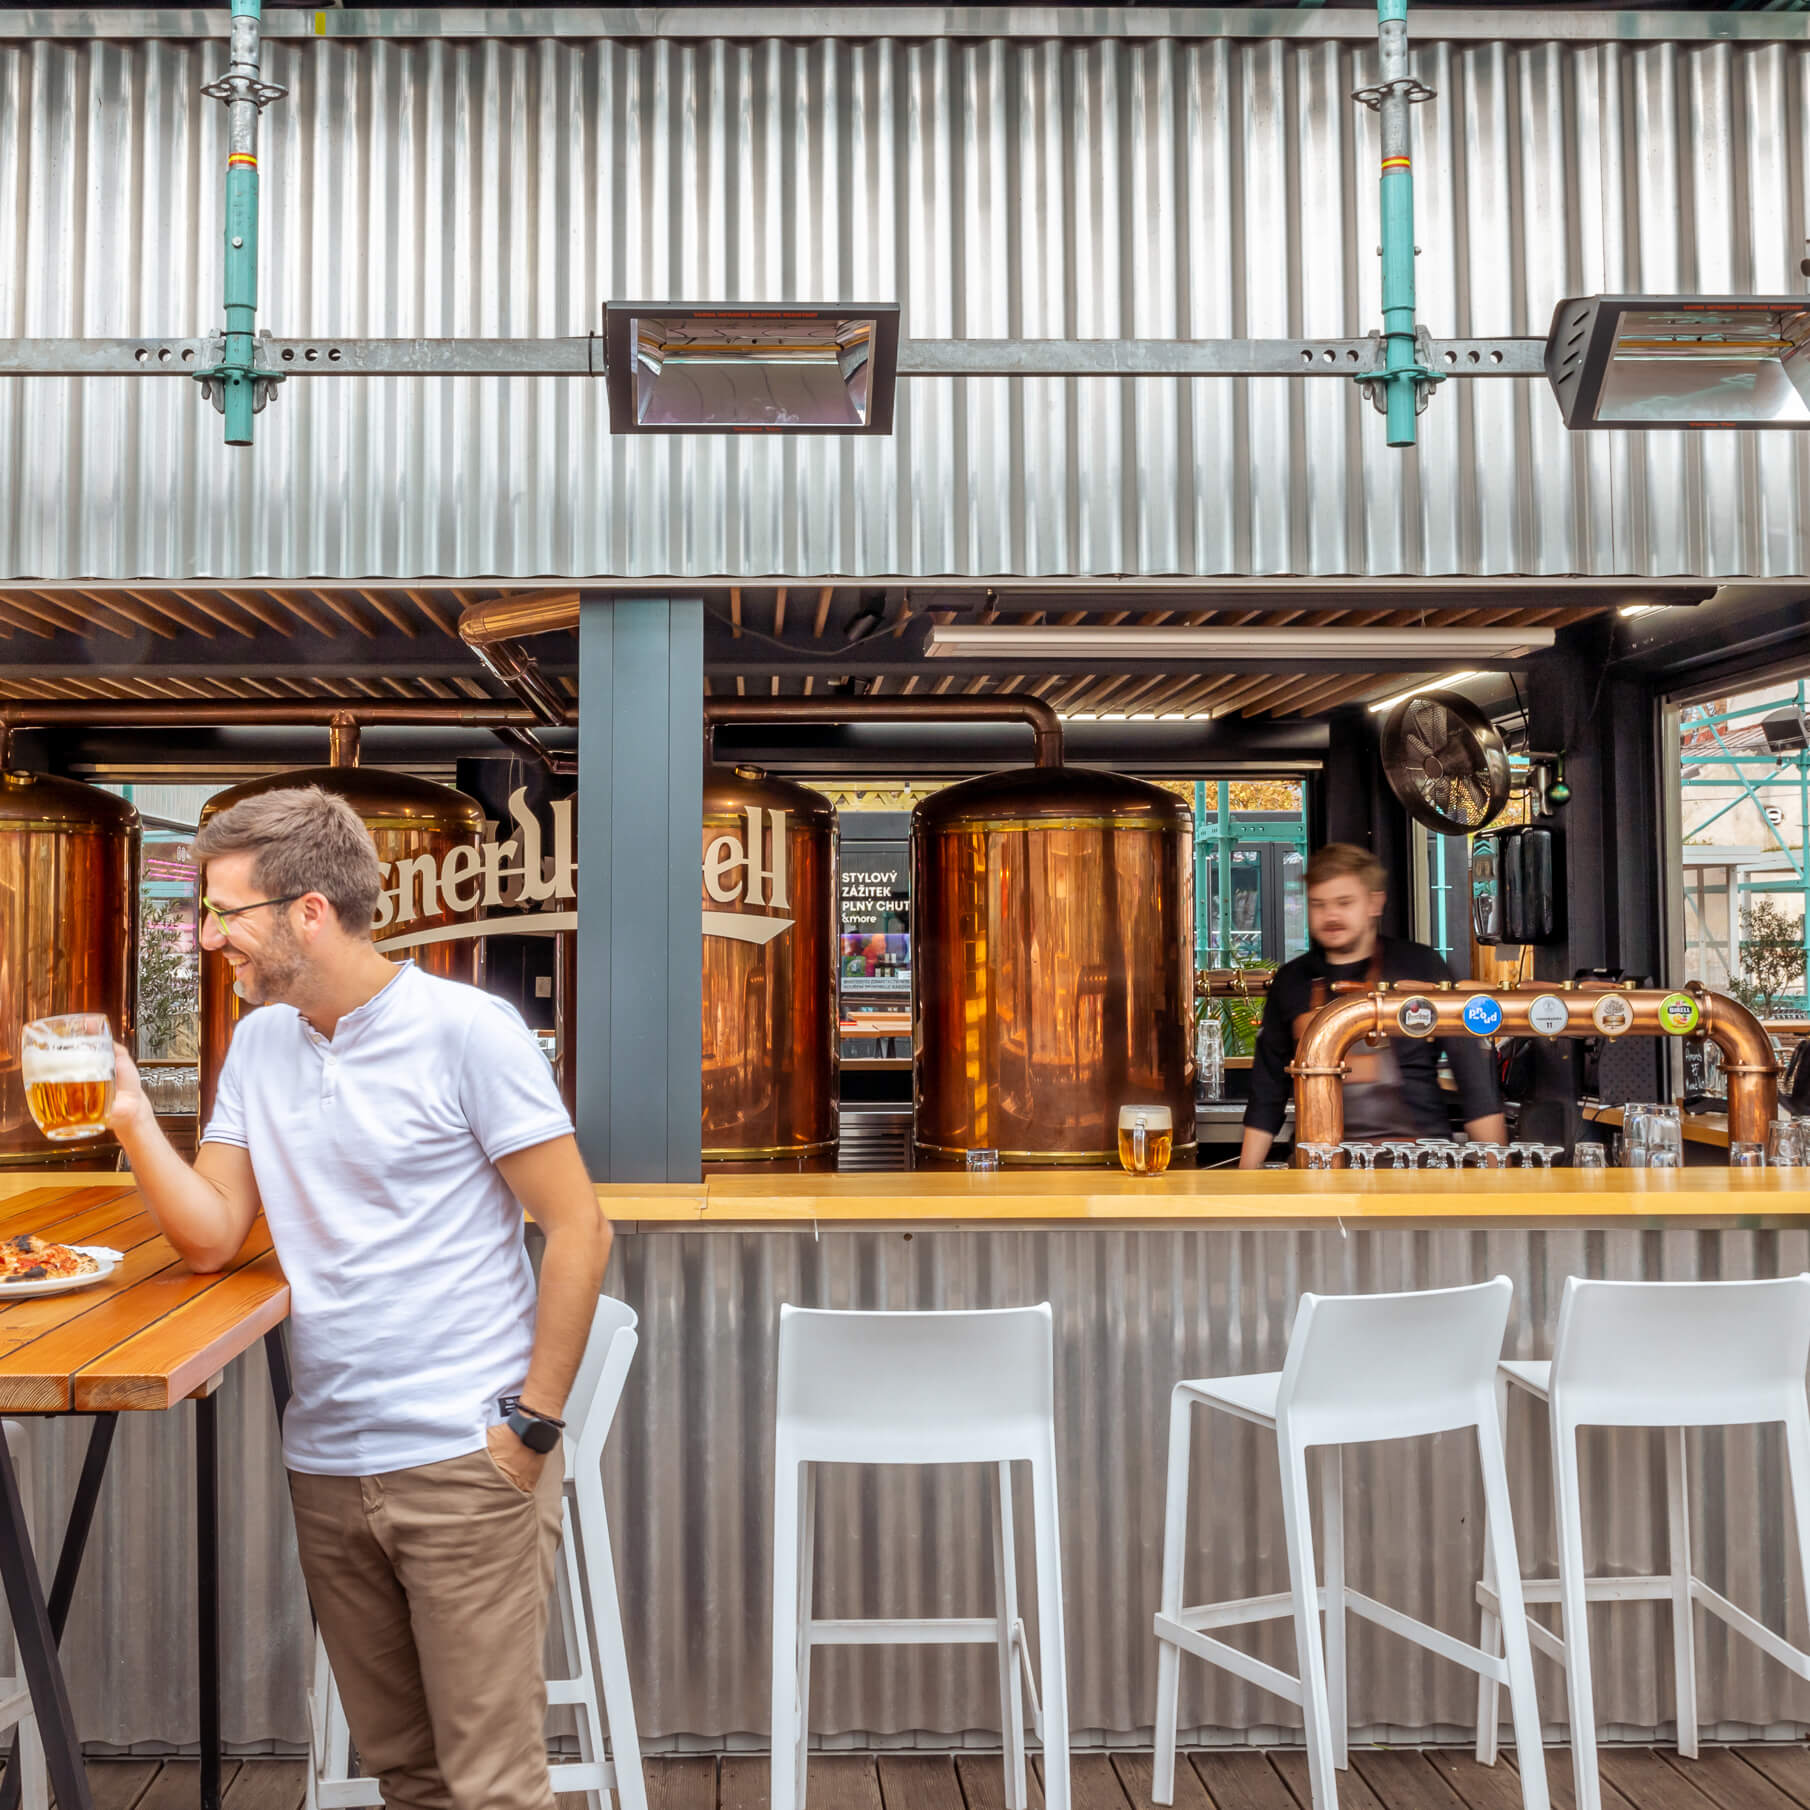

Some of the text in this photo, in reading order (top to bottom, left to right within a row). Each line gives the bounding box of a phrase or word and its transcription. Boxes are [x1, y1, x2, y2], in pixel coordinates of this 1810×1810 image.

[841, 870, 898, 883] STYLOVÝ
[370, 839, 518, 930] sner
[841, 885, 892, 897] ZÁŽITEK
[842, 898, 874, 911] PLNÝ
[841, 912, 877, 924] &more
